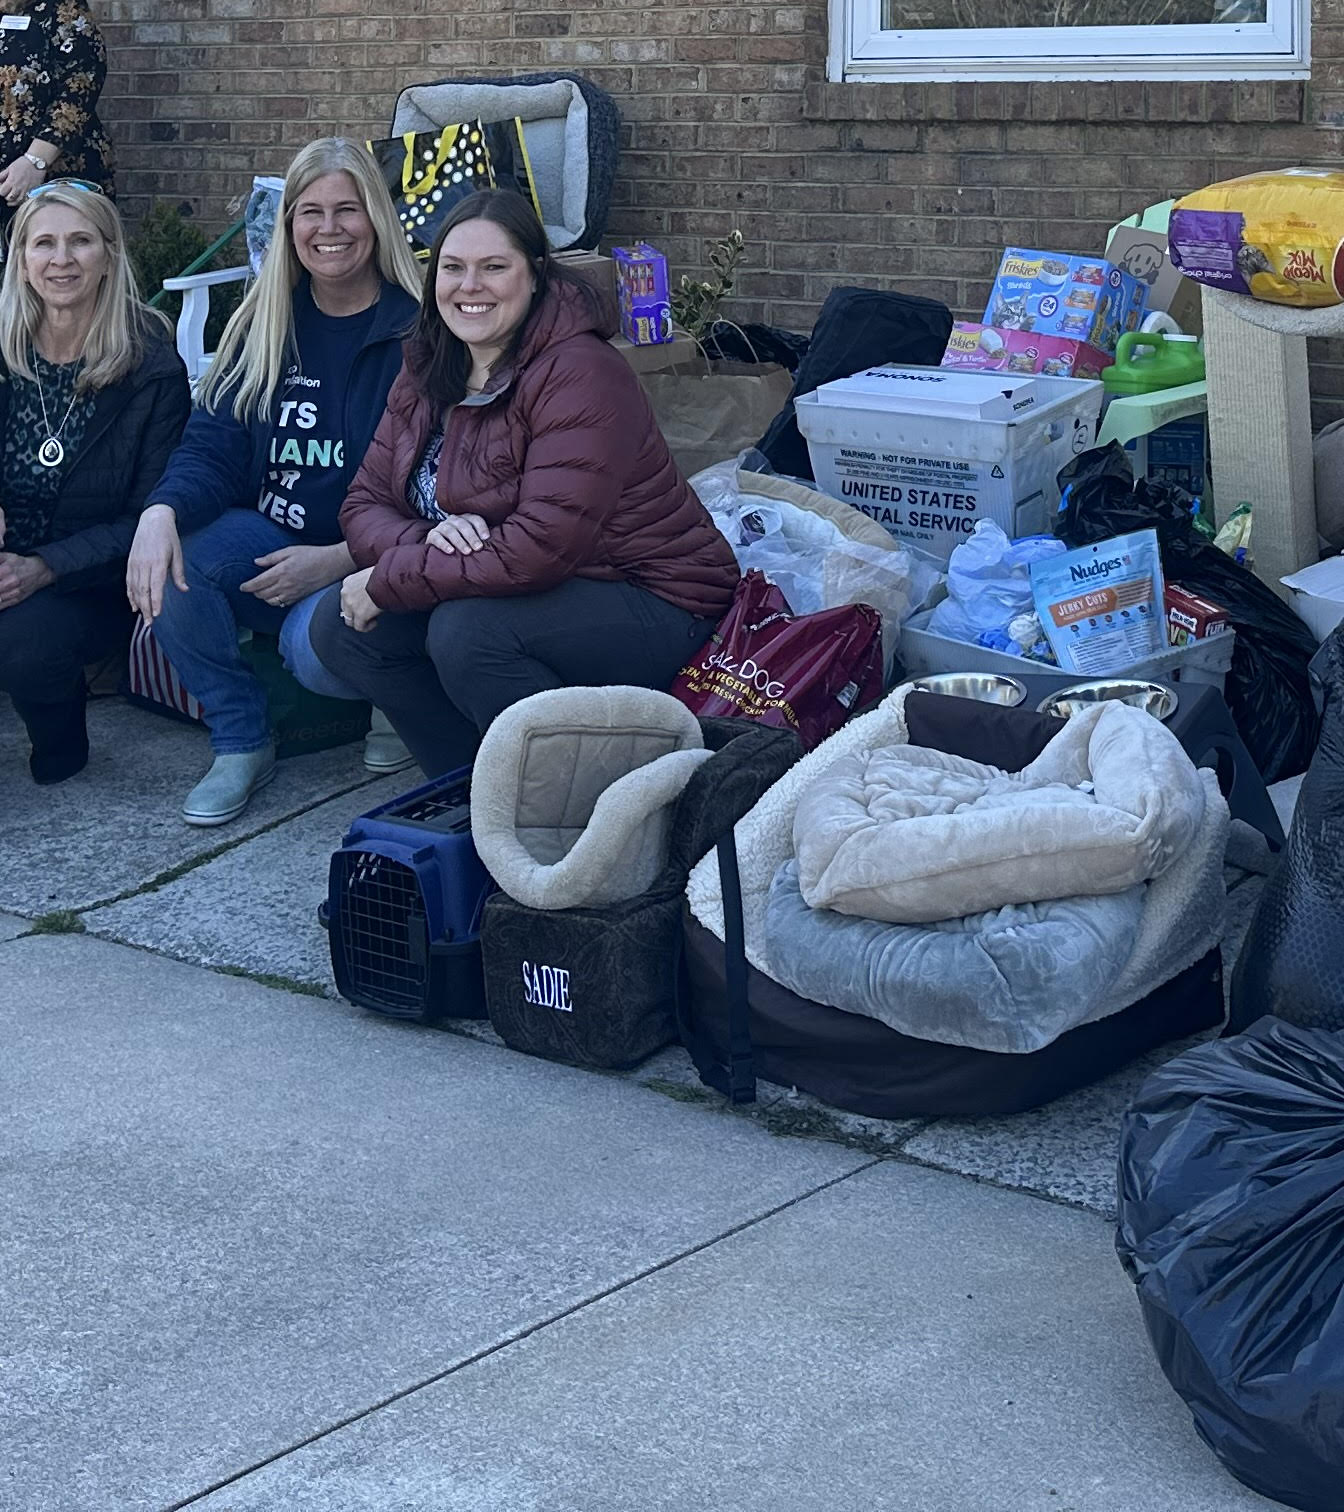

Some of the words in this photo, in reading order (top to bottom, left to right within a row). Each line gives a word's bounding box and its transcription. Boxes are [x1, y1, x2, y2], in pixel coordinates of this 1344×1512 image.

[1004, 260, 1039, 276] Friskies
[1288, 249, 1318, 268] Mix
[1282, 265, 1326, 284] Meow
[1042, 299, 1056, 309] 24
[949, 335, 976, 349] iskies
[864, 371, 948, 383] SONOMA
[278, 400, 318, 429] TS
[840, 448, 876, 461] WARNING
[882, 453, 899, 463] NOT
[900, 456, 916, 465] FOR
[918, 458, 951, 469] PRIVATE
[952, 462, 970, 471] USE
[841, 479, 903, 503] UNITED
[907, 488, 977, 512] STATES
[258, 491, 307, 530] VES
[908, 511, 979, 534] SERVIC
[1069, 557, 1122, 582] Nudges
[715, 671, 763, 707] VEGETABLE
[738, 659, 786, 698] DOG
[711, 685, 736, 703] FRESH
[522, 960, 573, 1012] SADIE
